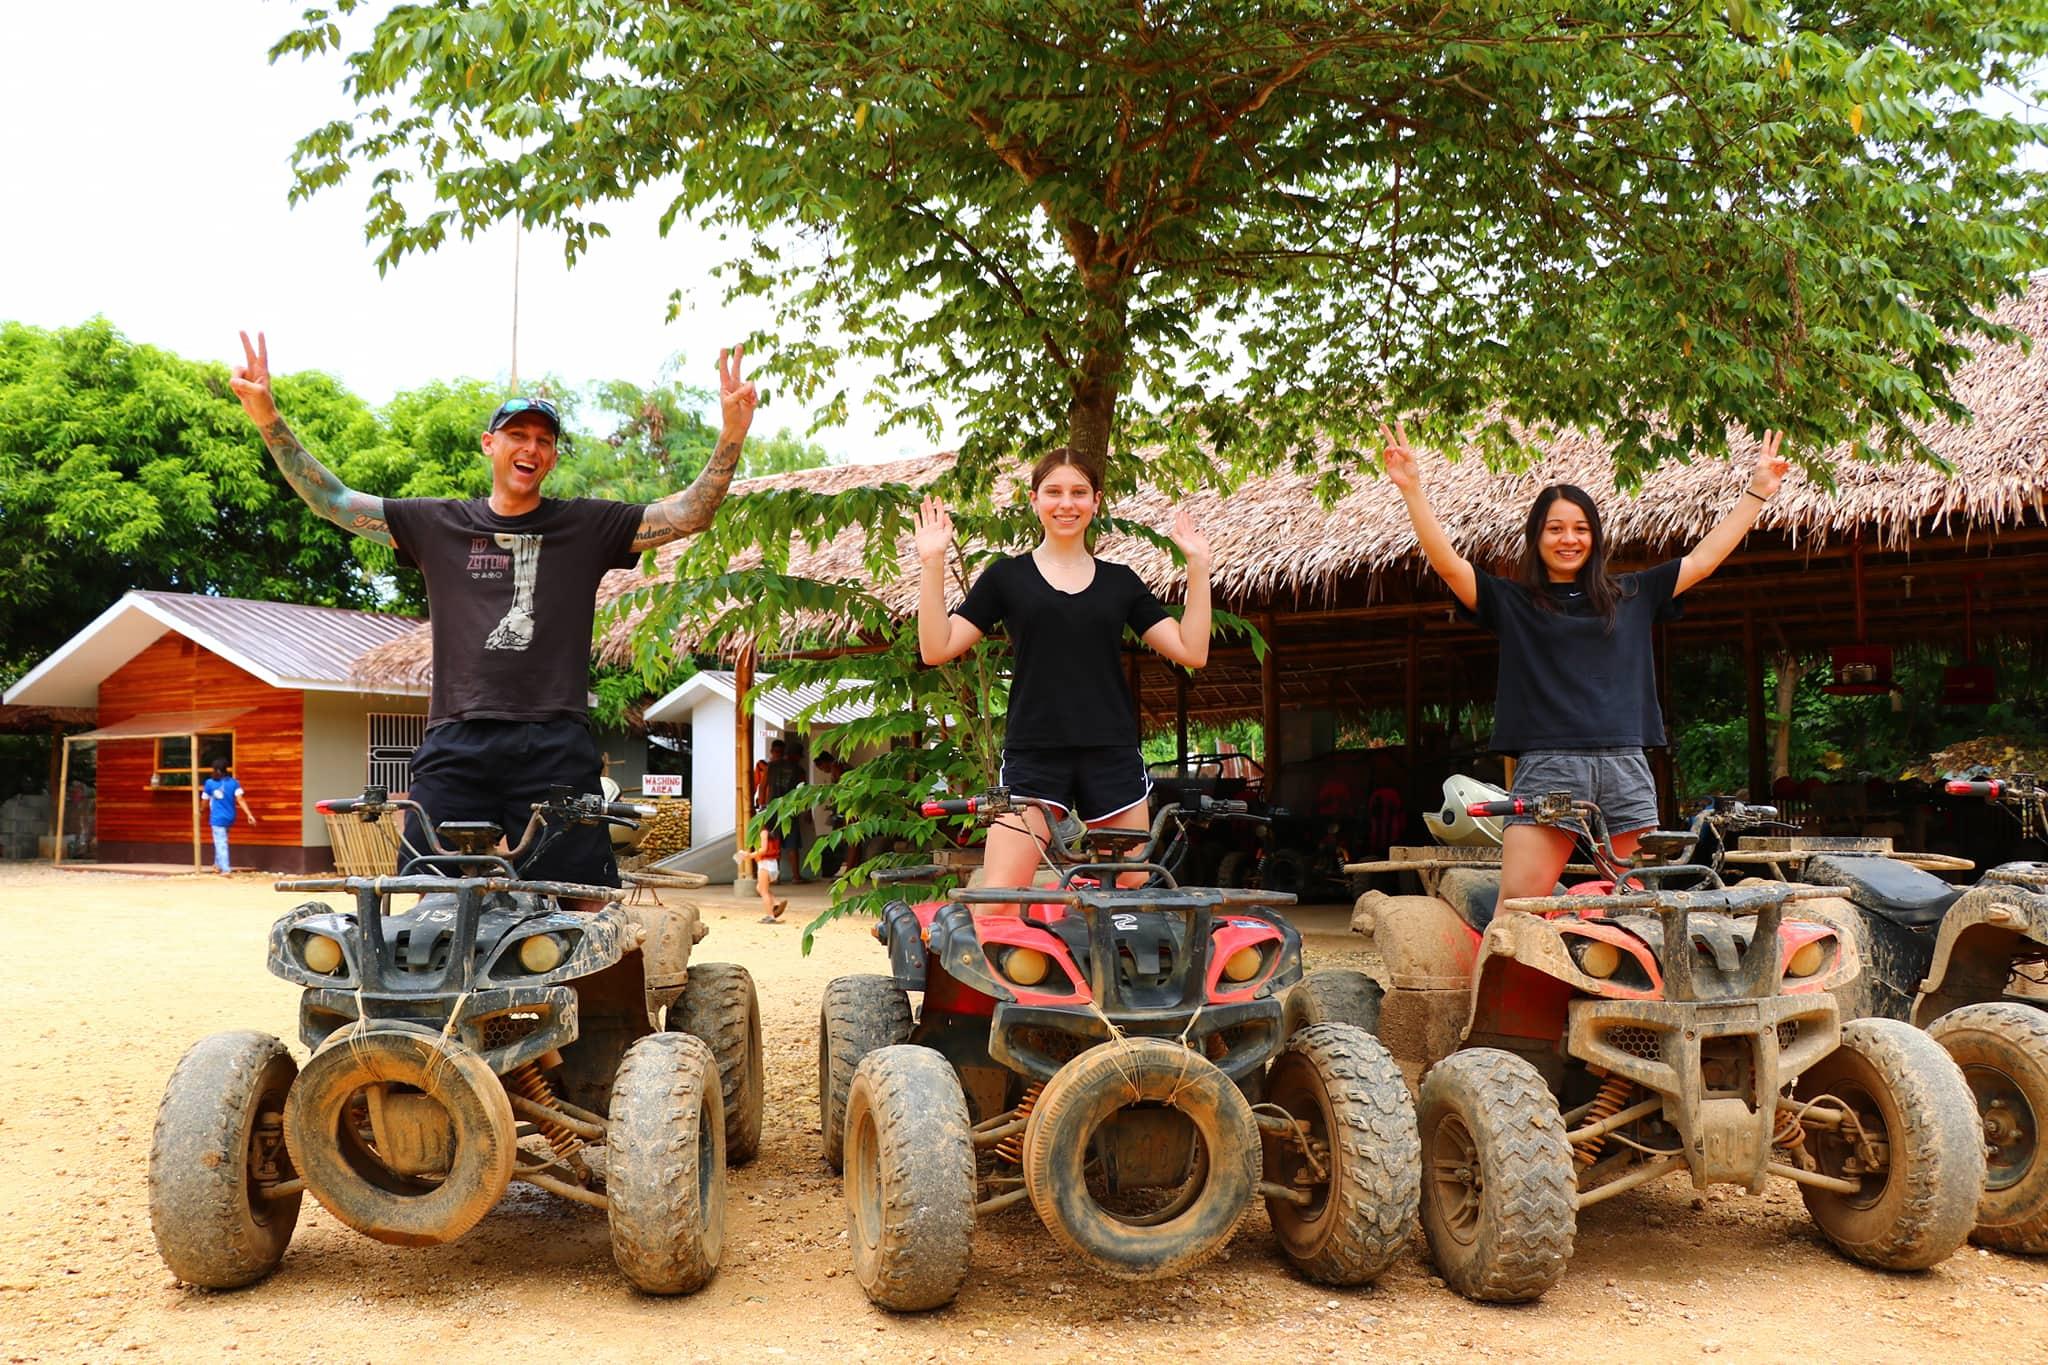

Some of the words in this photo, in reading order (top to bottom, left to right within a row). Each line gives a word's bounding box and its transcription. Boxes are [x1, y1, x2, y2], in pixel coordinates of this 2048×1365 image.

[471, 537, 488, 553] LED
[644, 776, 680, 785] WASHING
[651, 785, 673, 793] AREA
[1111, 914, 1138, 930] 2
